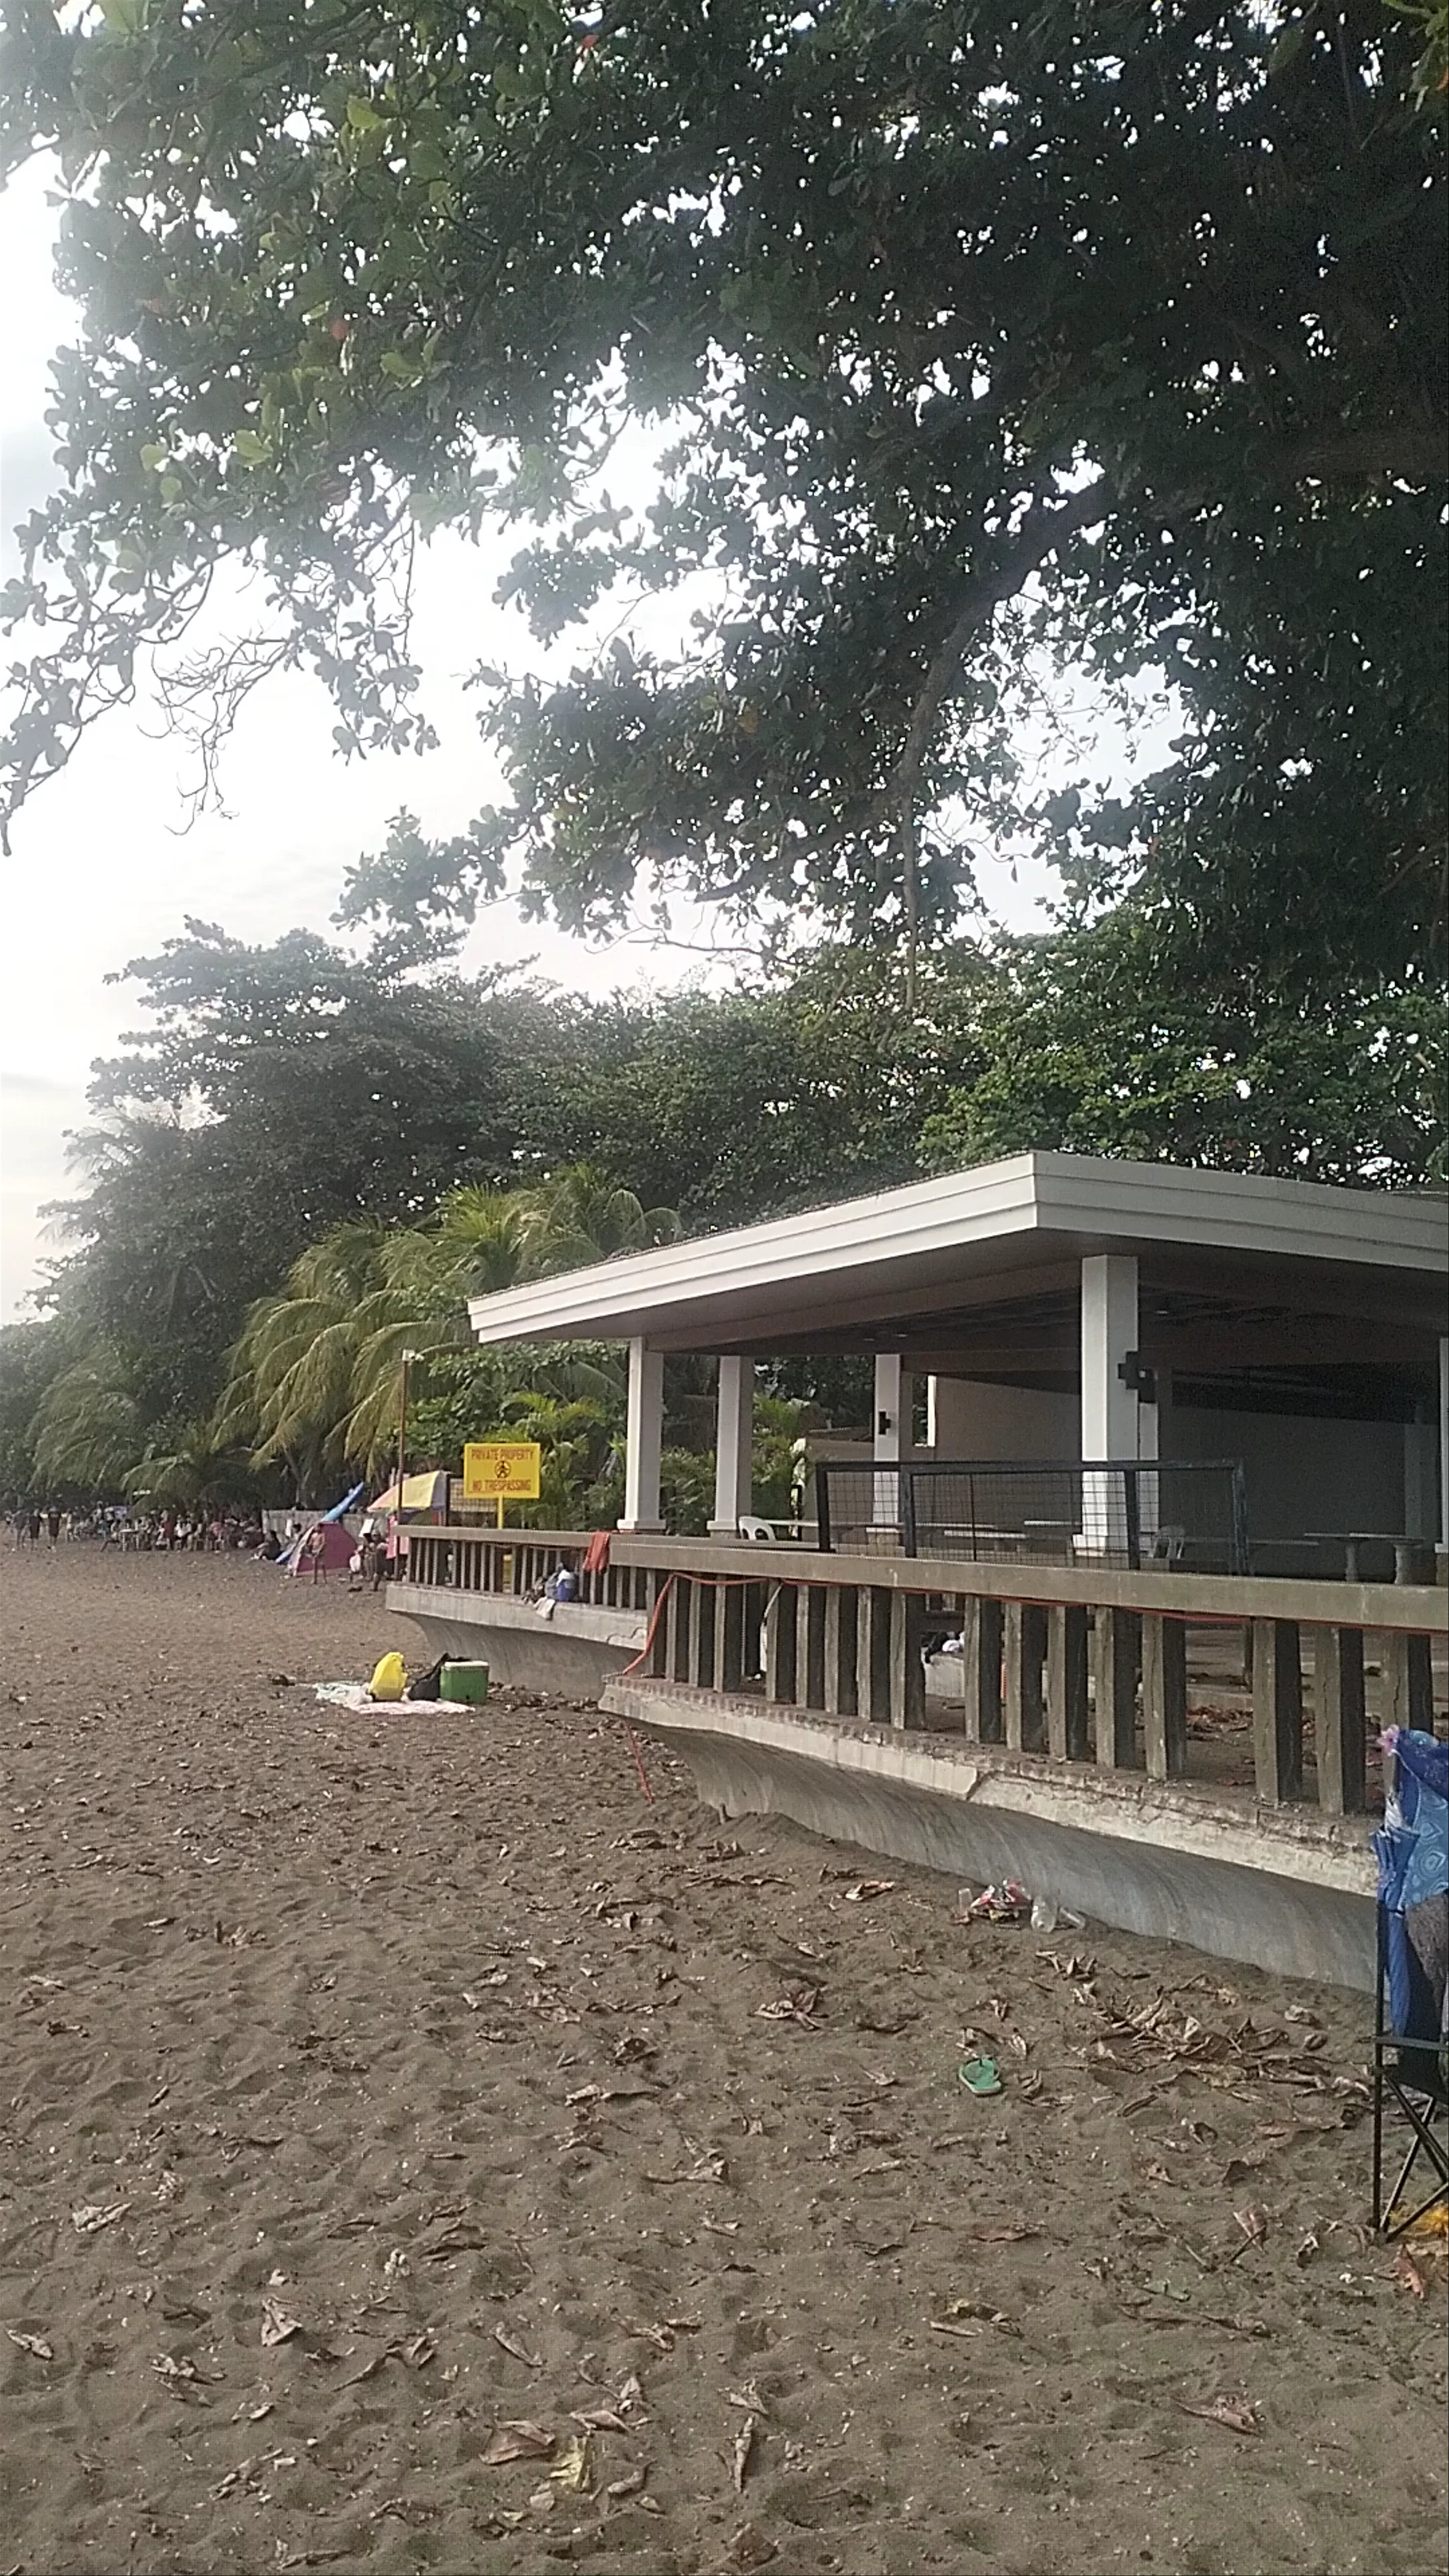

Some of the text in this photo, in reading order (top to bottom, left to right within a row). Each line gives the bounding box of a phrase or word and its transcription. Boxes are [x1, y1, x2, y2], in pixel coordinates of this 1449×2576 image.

[472, 1448, 534, 1460] PRIVATE PROPERTY
[473, 1479, 531, 1491] NO TRESPASSING
